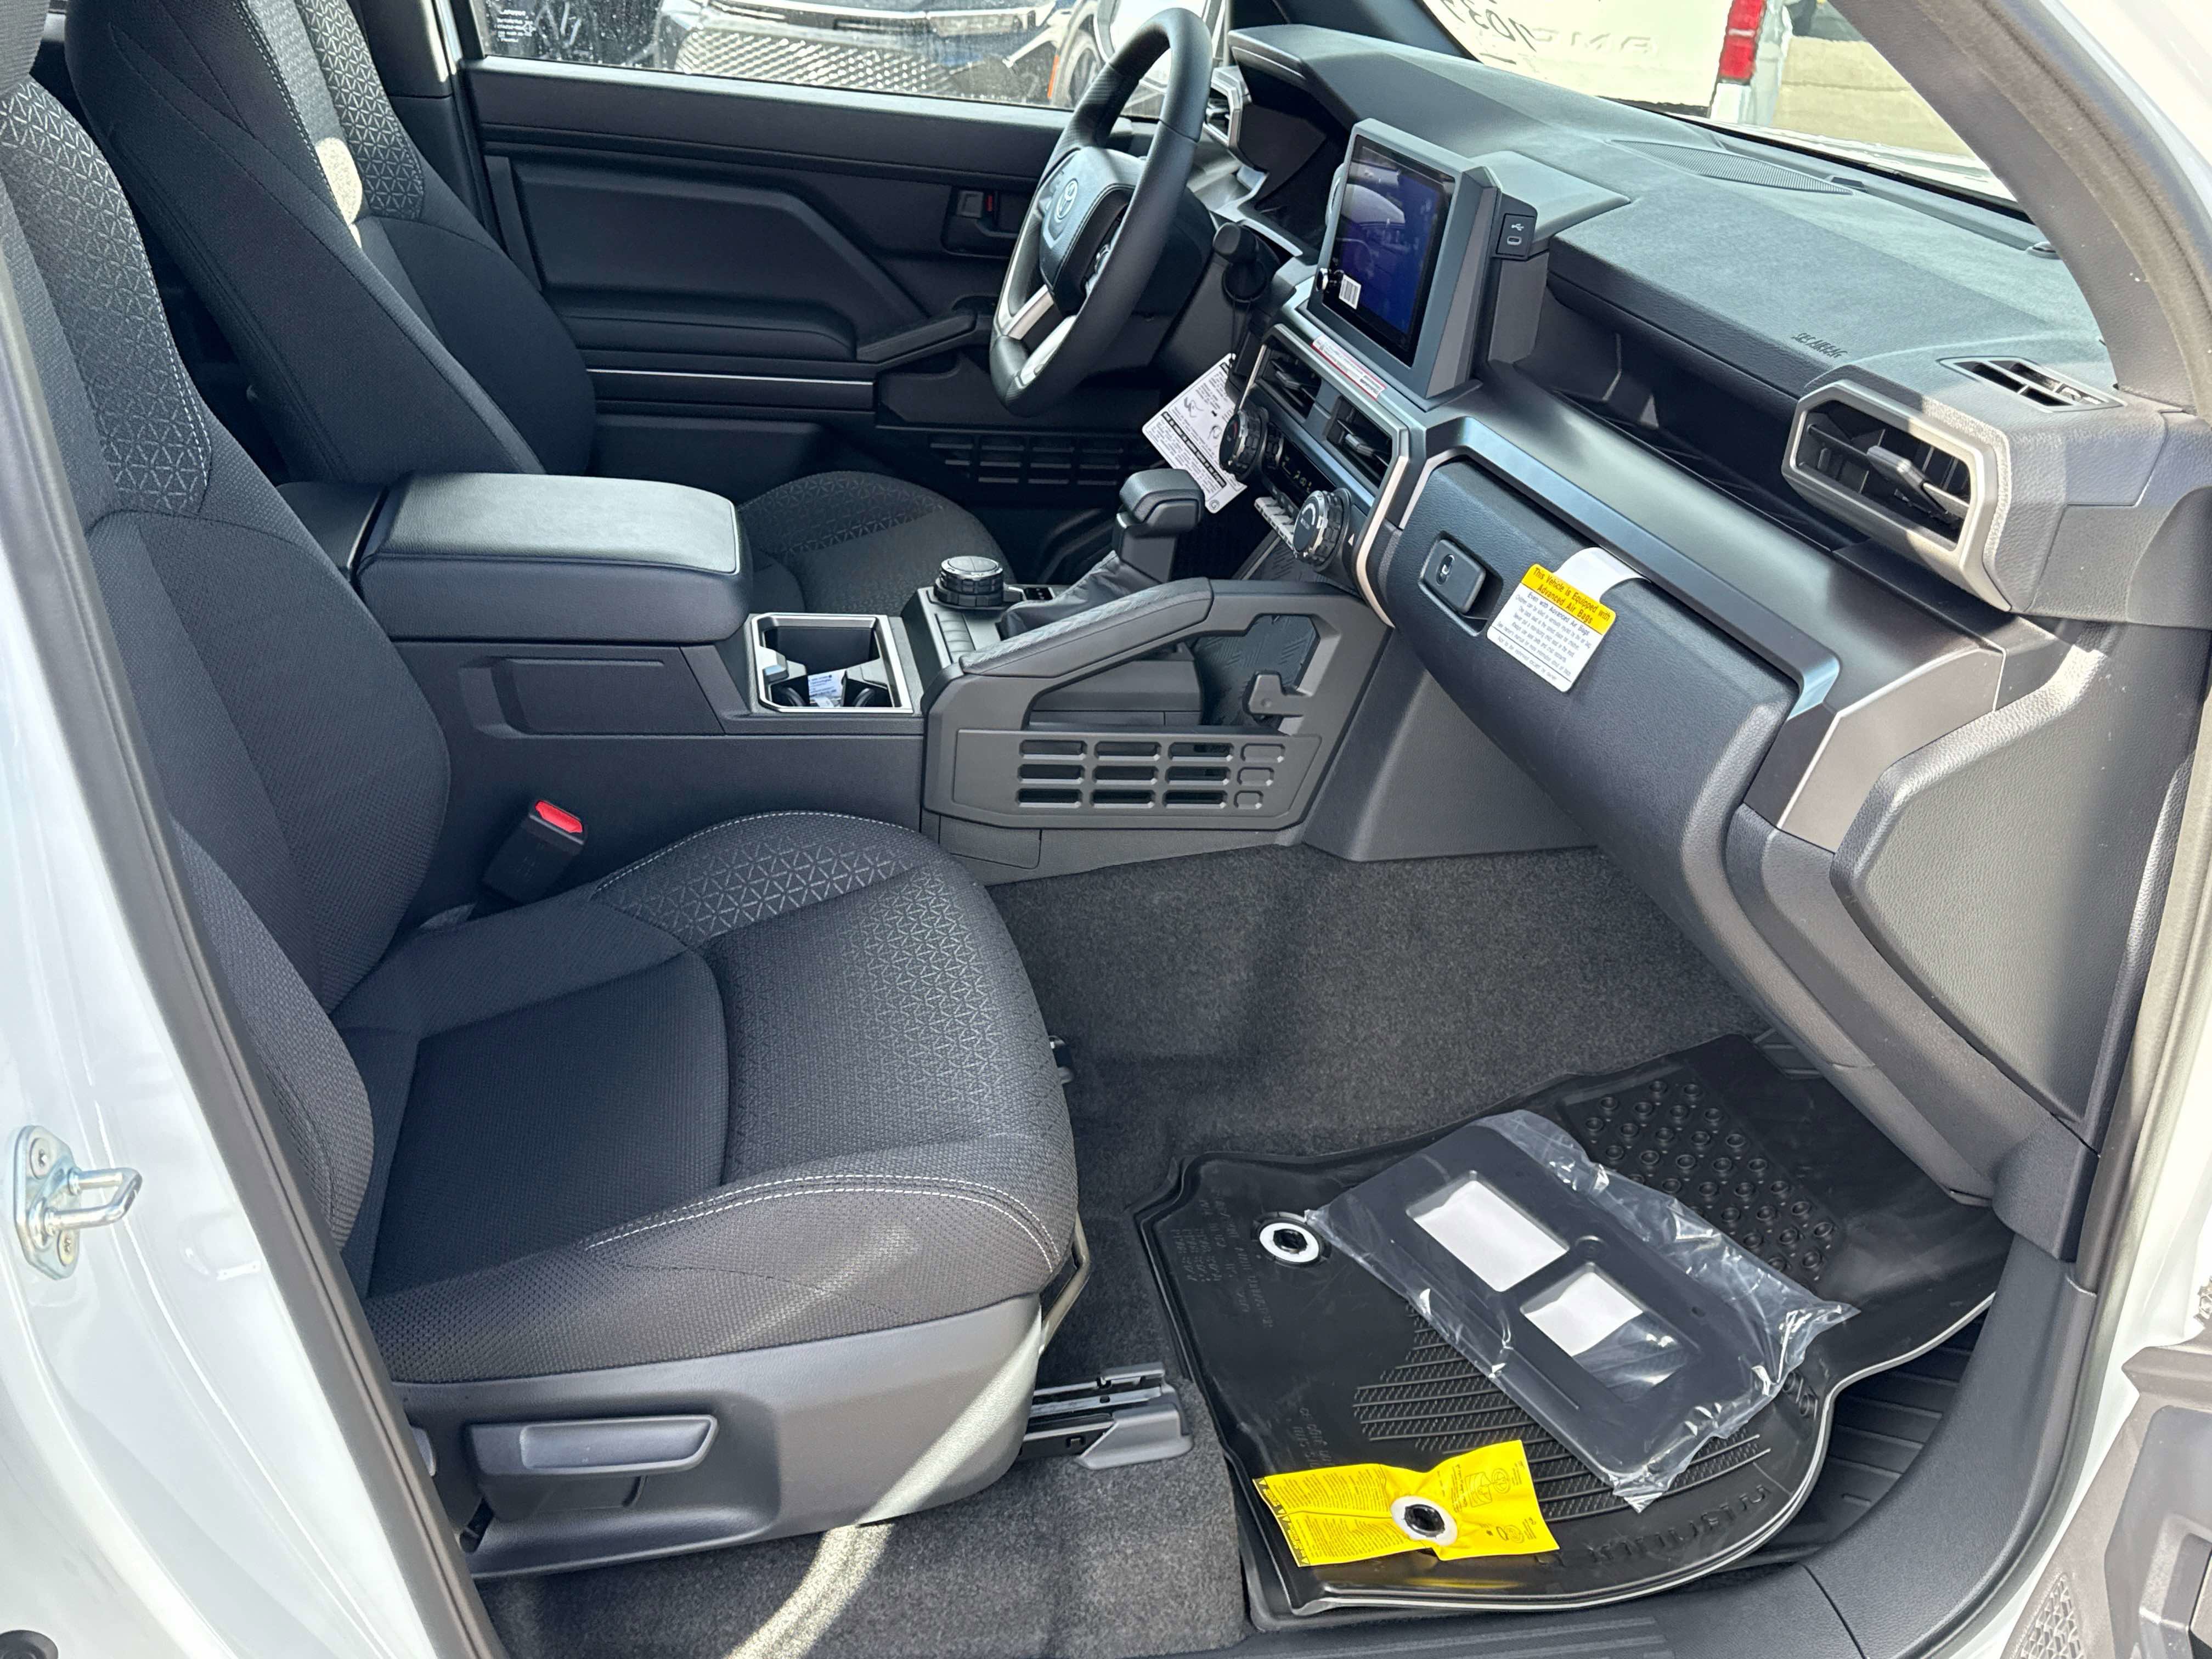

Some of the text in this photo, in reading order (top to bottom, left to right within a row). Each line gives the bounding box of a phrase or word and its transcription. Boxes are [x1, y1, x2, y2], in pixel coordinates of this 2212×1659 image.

[1533, 567, 1610, 621] This Vehicle is Equipped with
[1537, 584, 1593, 624] Advanced Air Bags
